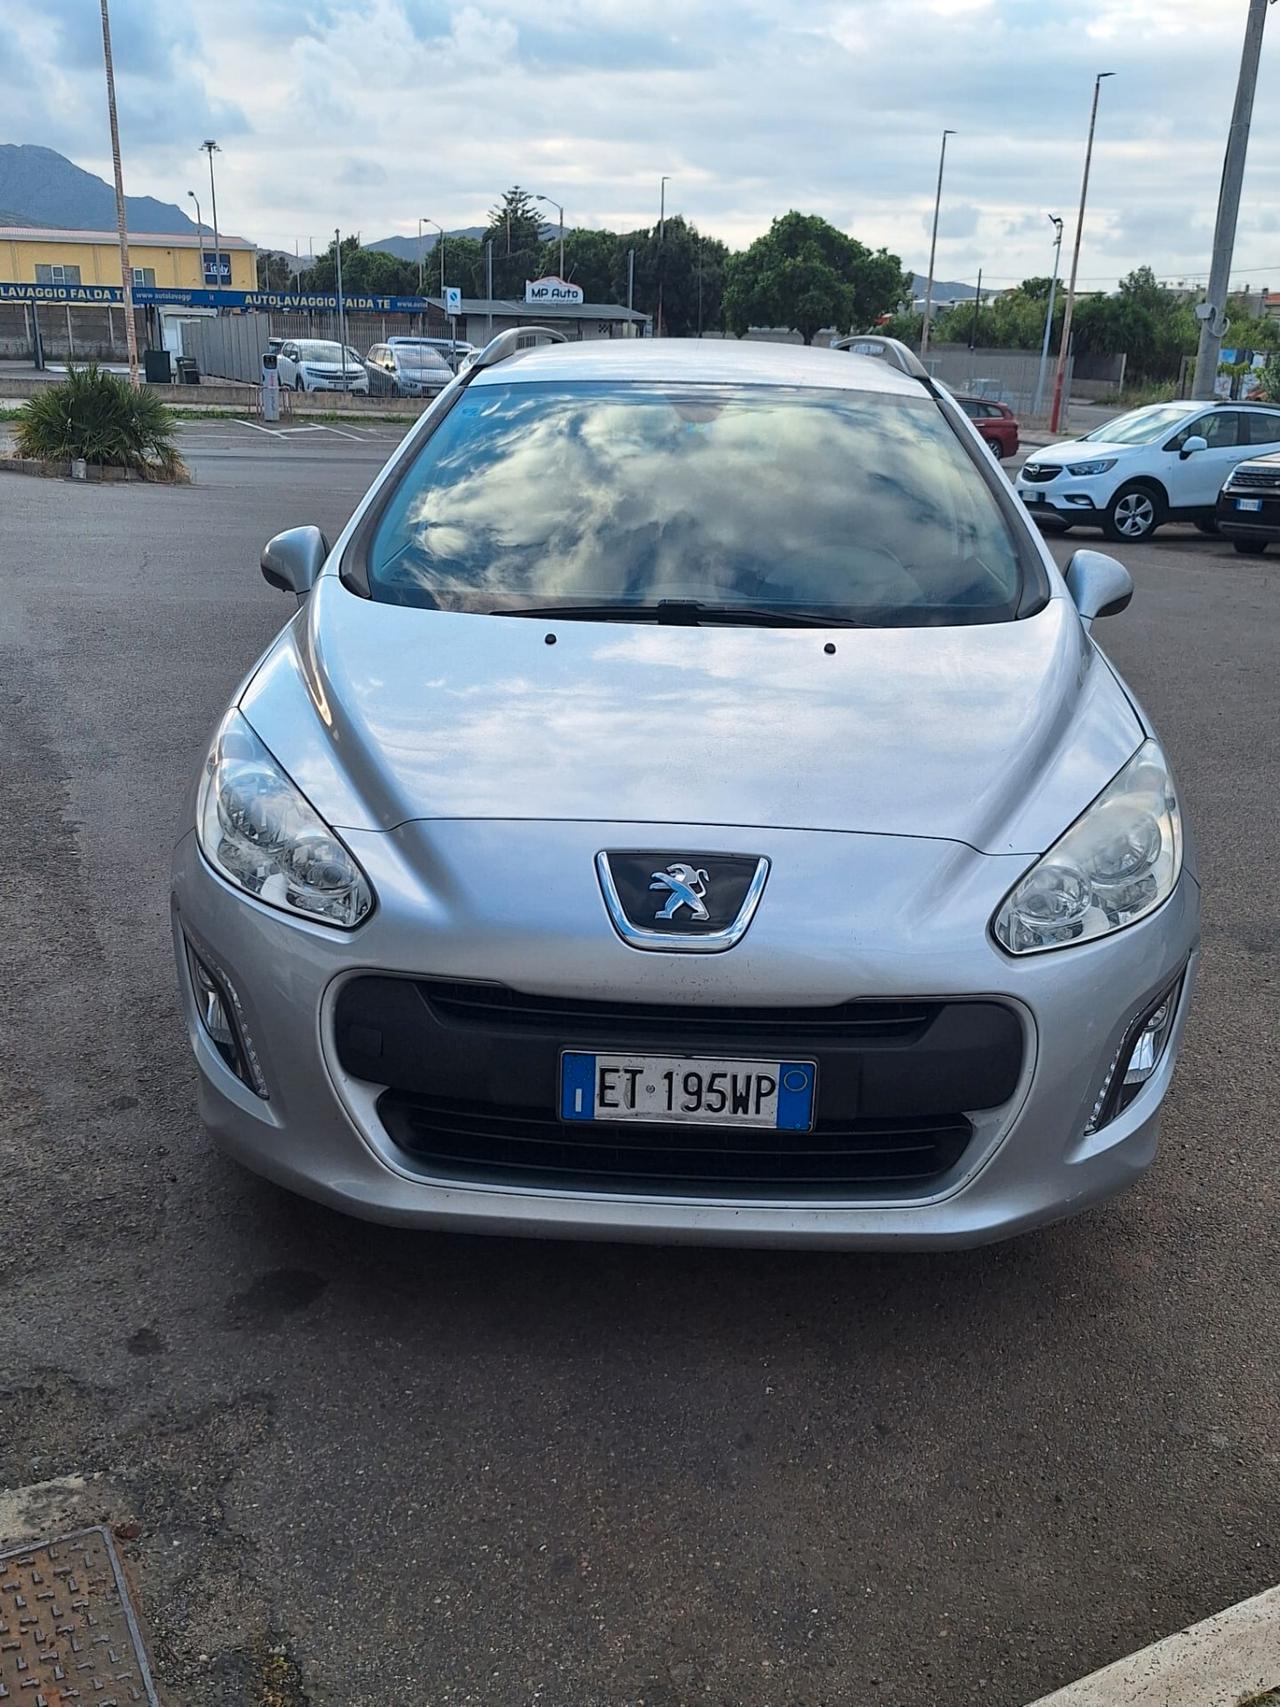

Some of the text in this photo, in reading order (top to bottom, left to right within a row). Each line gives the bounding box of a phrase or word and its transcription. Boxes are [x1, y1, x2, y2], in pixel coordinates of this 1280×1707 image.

[0, 287, 67, 298] LAVAGGIO
[531, 288, 579, 298] MP Auto
[244, 295, 336, 307] AUTOLAVAGGIO
[599, 1067, 776, 1115] ET 195WP
